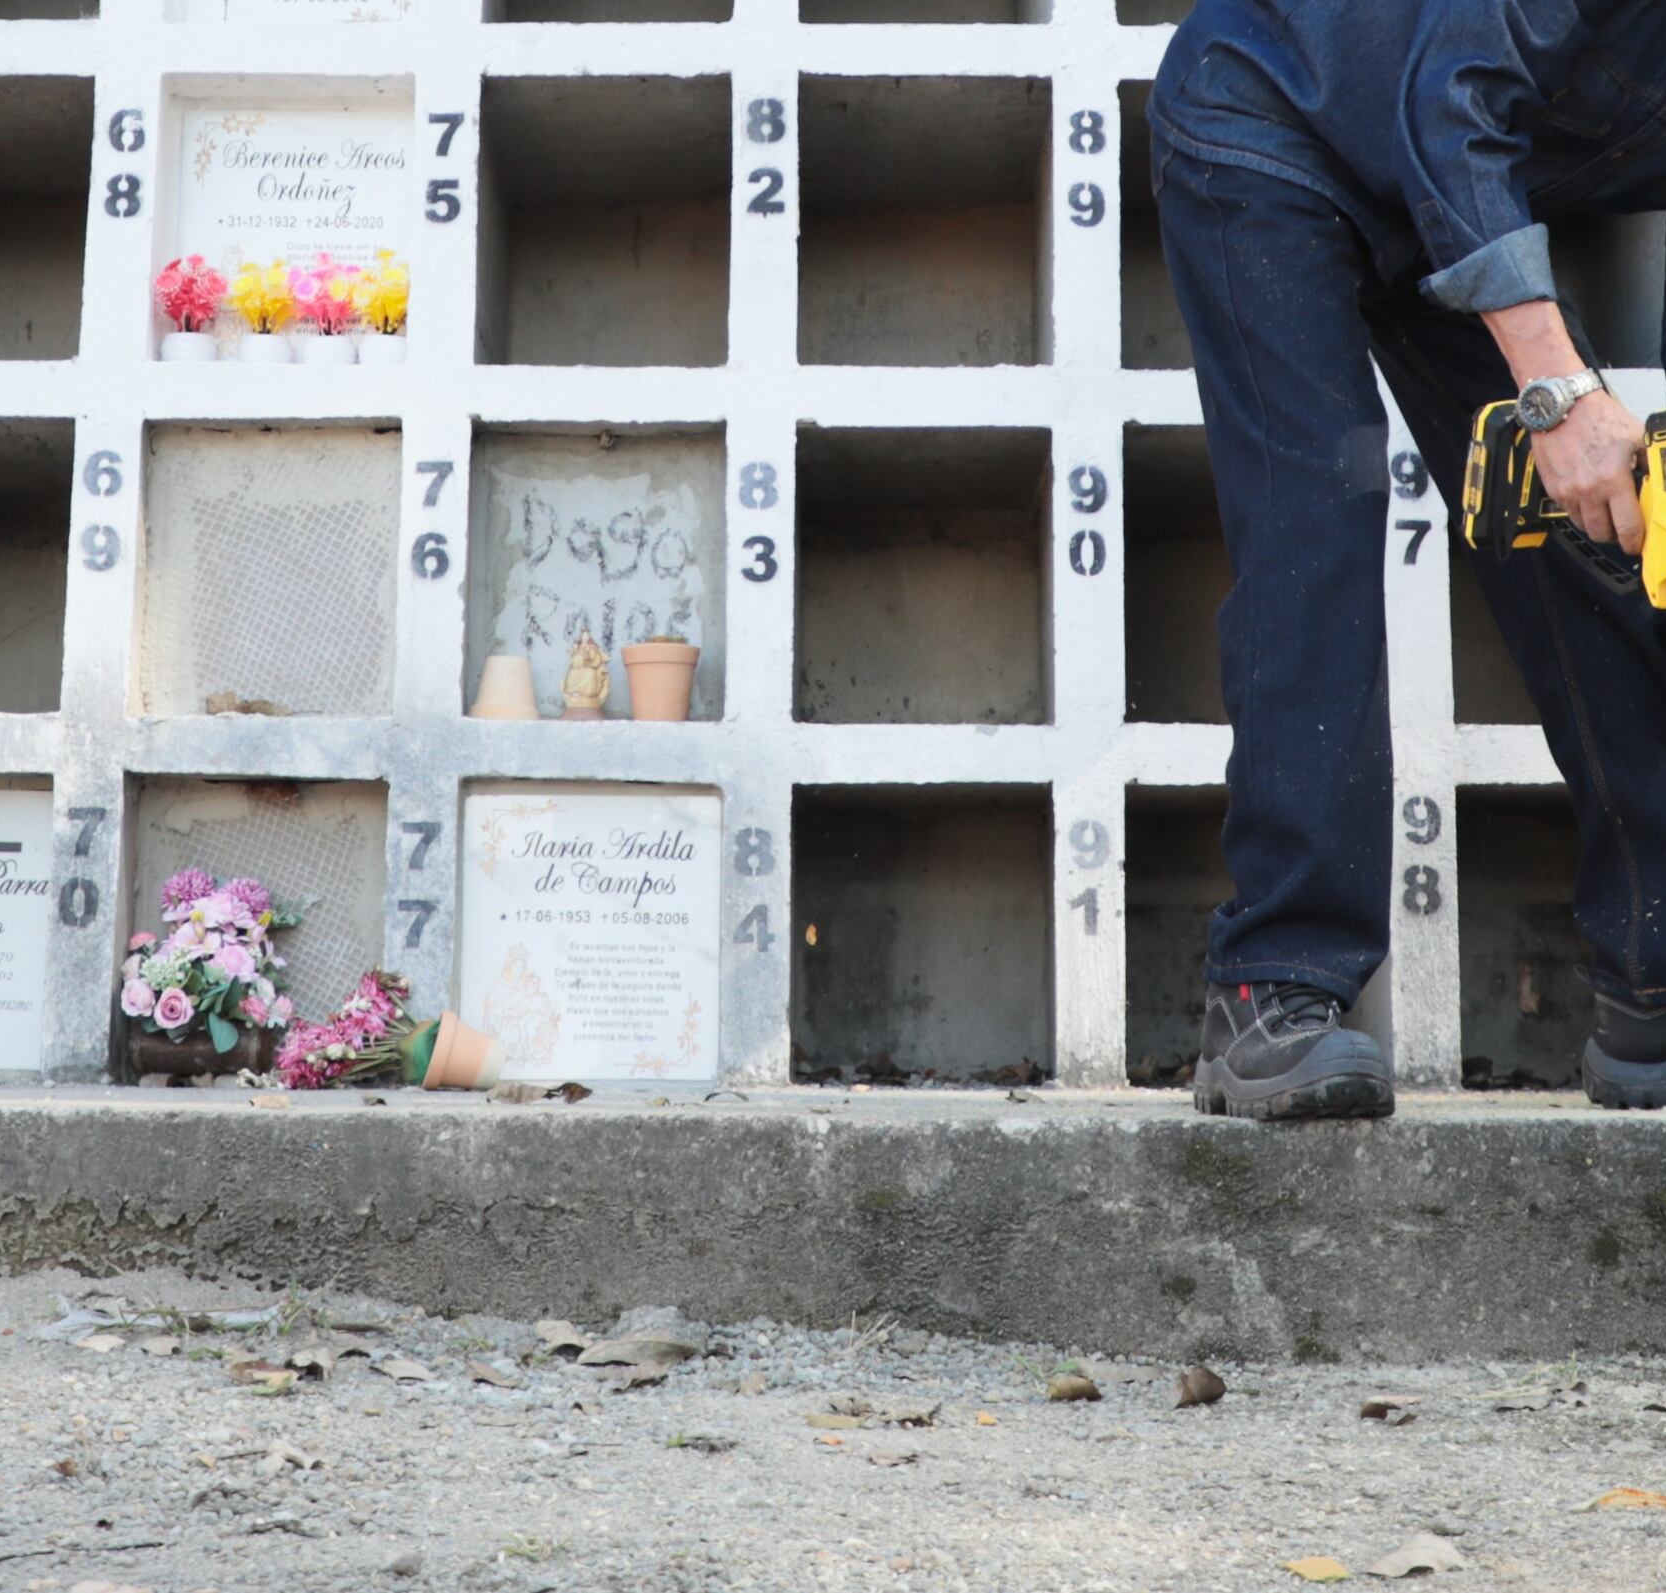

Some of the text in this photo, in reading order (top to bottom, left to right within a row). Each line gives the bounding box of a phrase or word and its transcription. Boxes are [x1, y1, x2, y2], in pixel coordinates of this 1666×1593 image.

[222, 140, 406, 170] Berenice Arcos
[257, 172, 355, 216] Ordoñez
[603, 830, 695, 862] Ardila
[535, 862, 677, 910] de Campos
